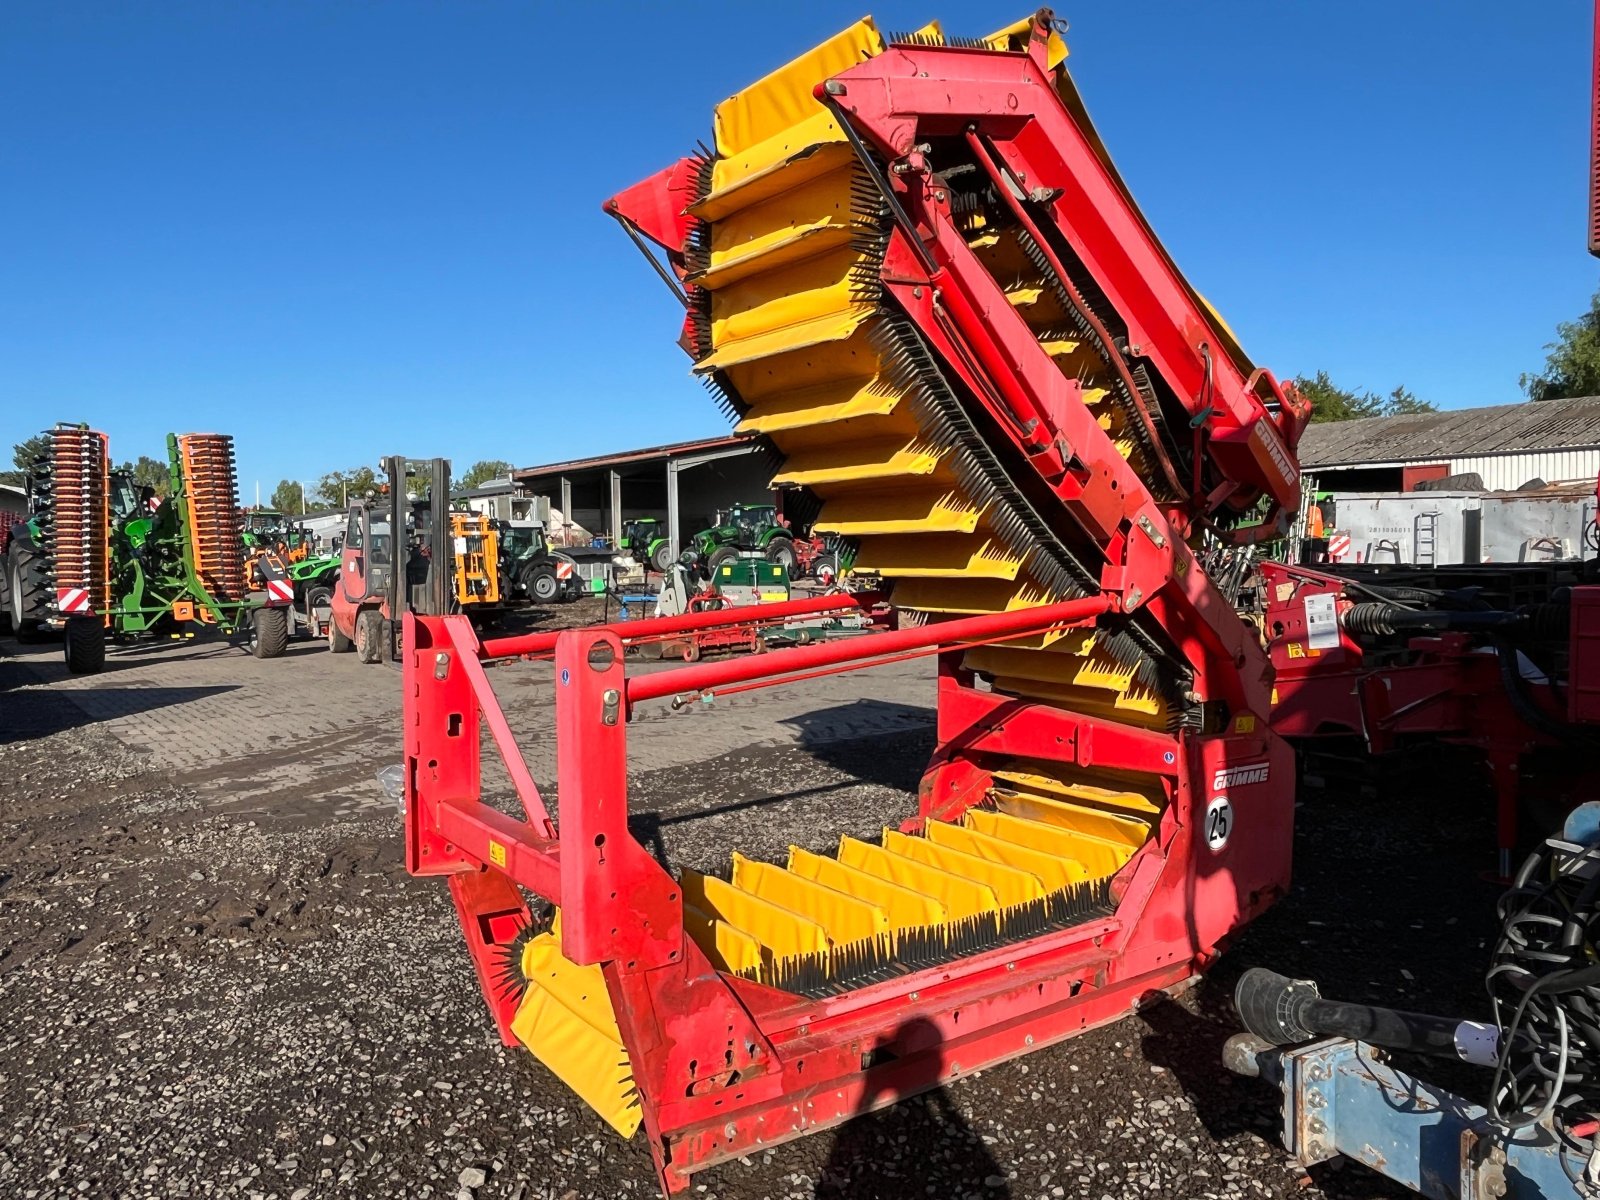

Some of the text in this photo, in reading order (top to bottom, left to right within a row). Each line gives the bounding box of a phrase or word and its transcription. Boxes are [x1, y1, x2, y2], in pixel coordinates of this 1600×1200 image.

[1254, 418, 1296, 486] GRIMME
[1213, 766, 1269, 791] GRIMME
[1209, 805, 1228, 842] 25
